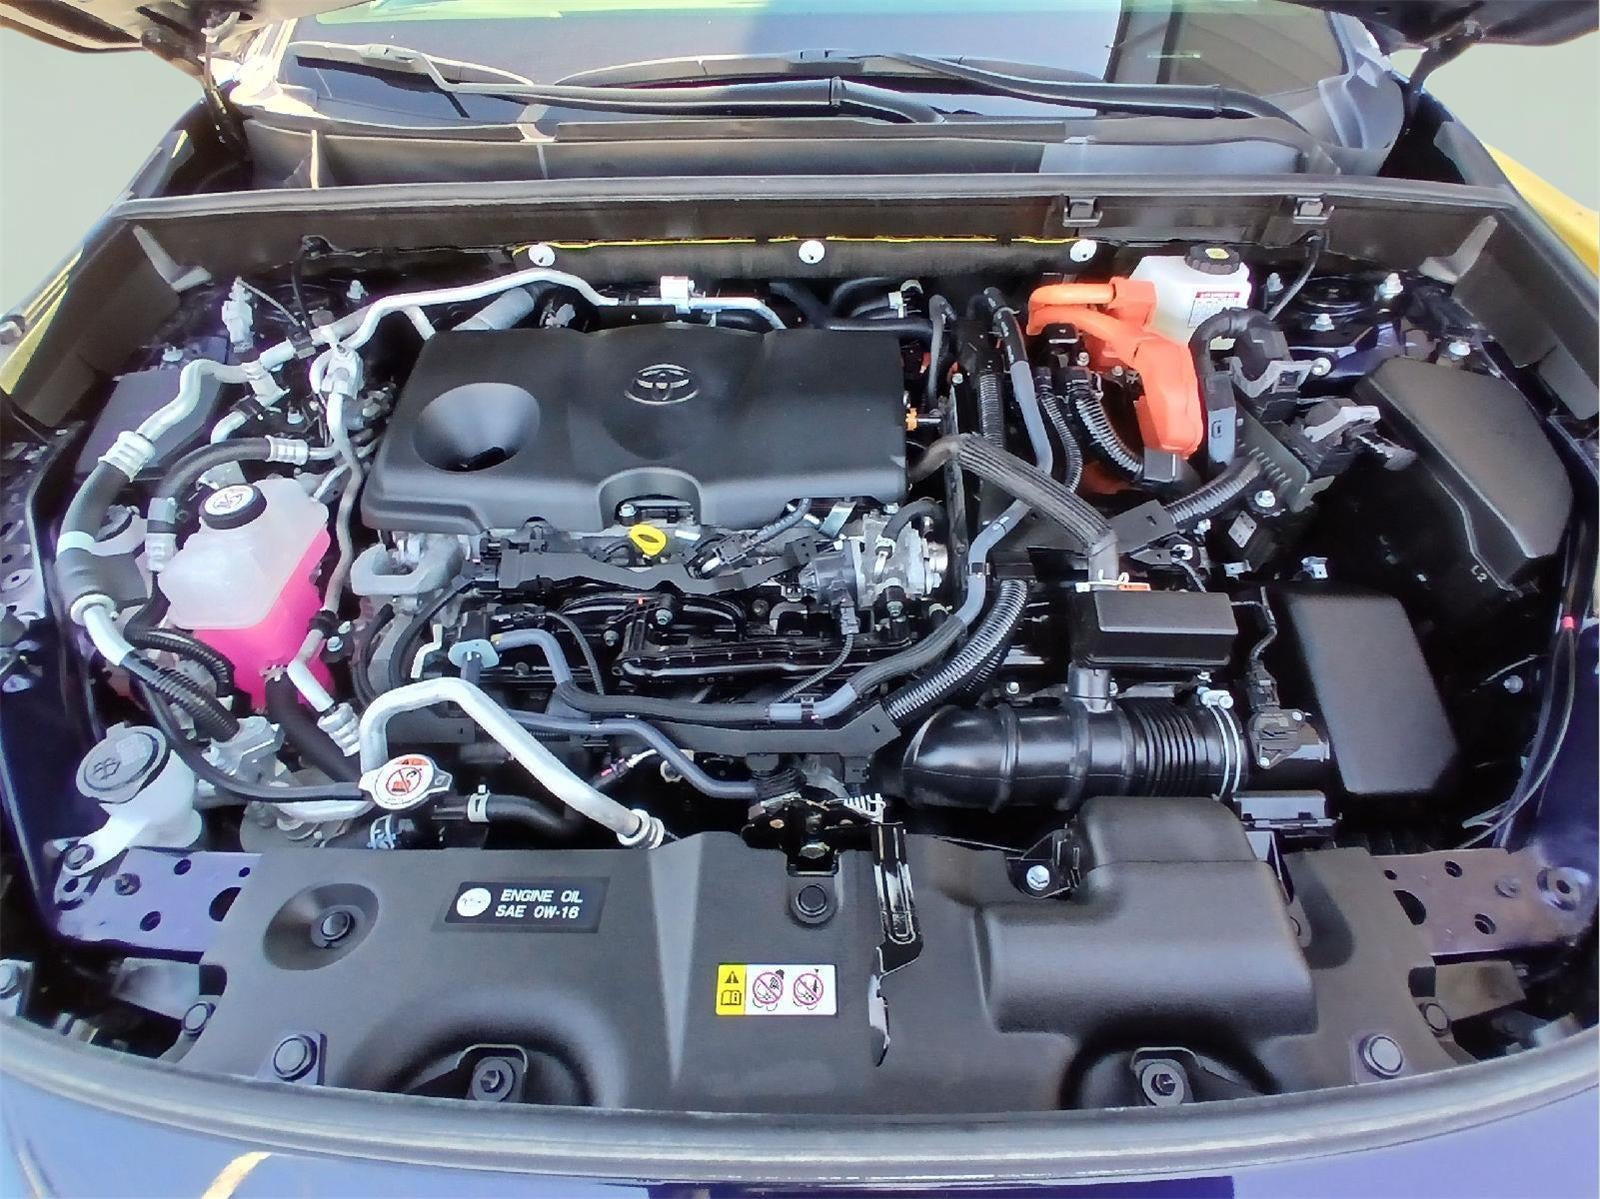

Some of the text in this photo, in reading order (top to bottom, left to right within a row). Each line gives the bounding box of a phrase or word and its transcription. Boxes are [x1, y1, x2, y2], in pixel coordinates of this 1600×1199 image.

[500, 889, 583, 903] ENGINE OIL
[495, 904, 580, 919] SAE 0W-16
